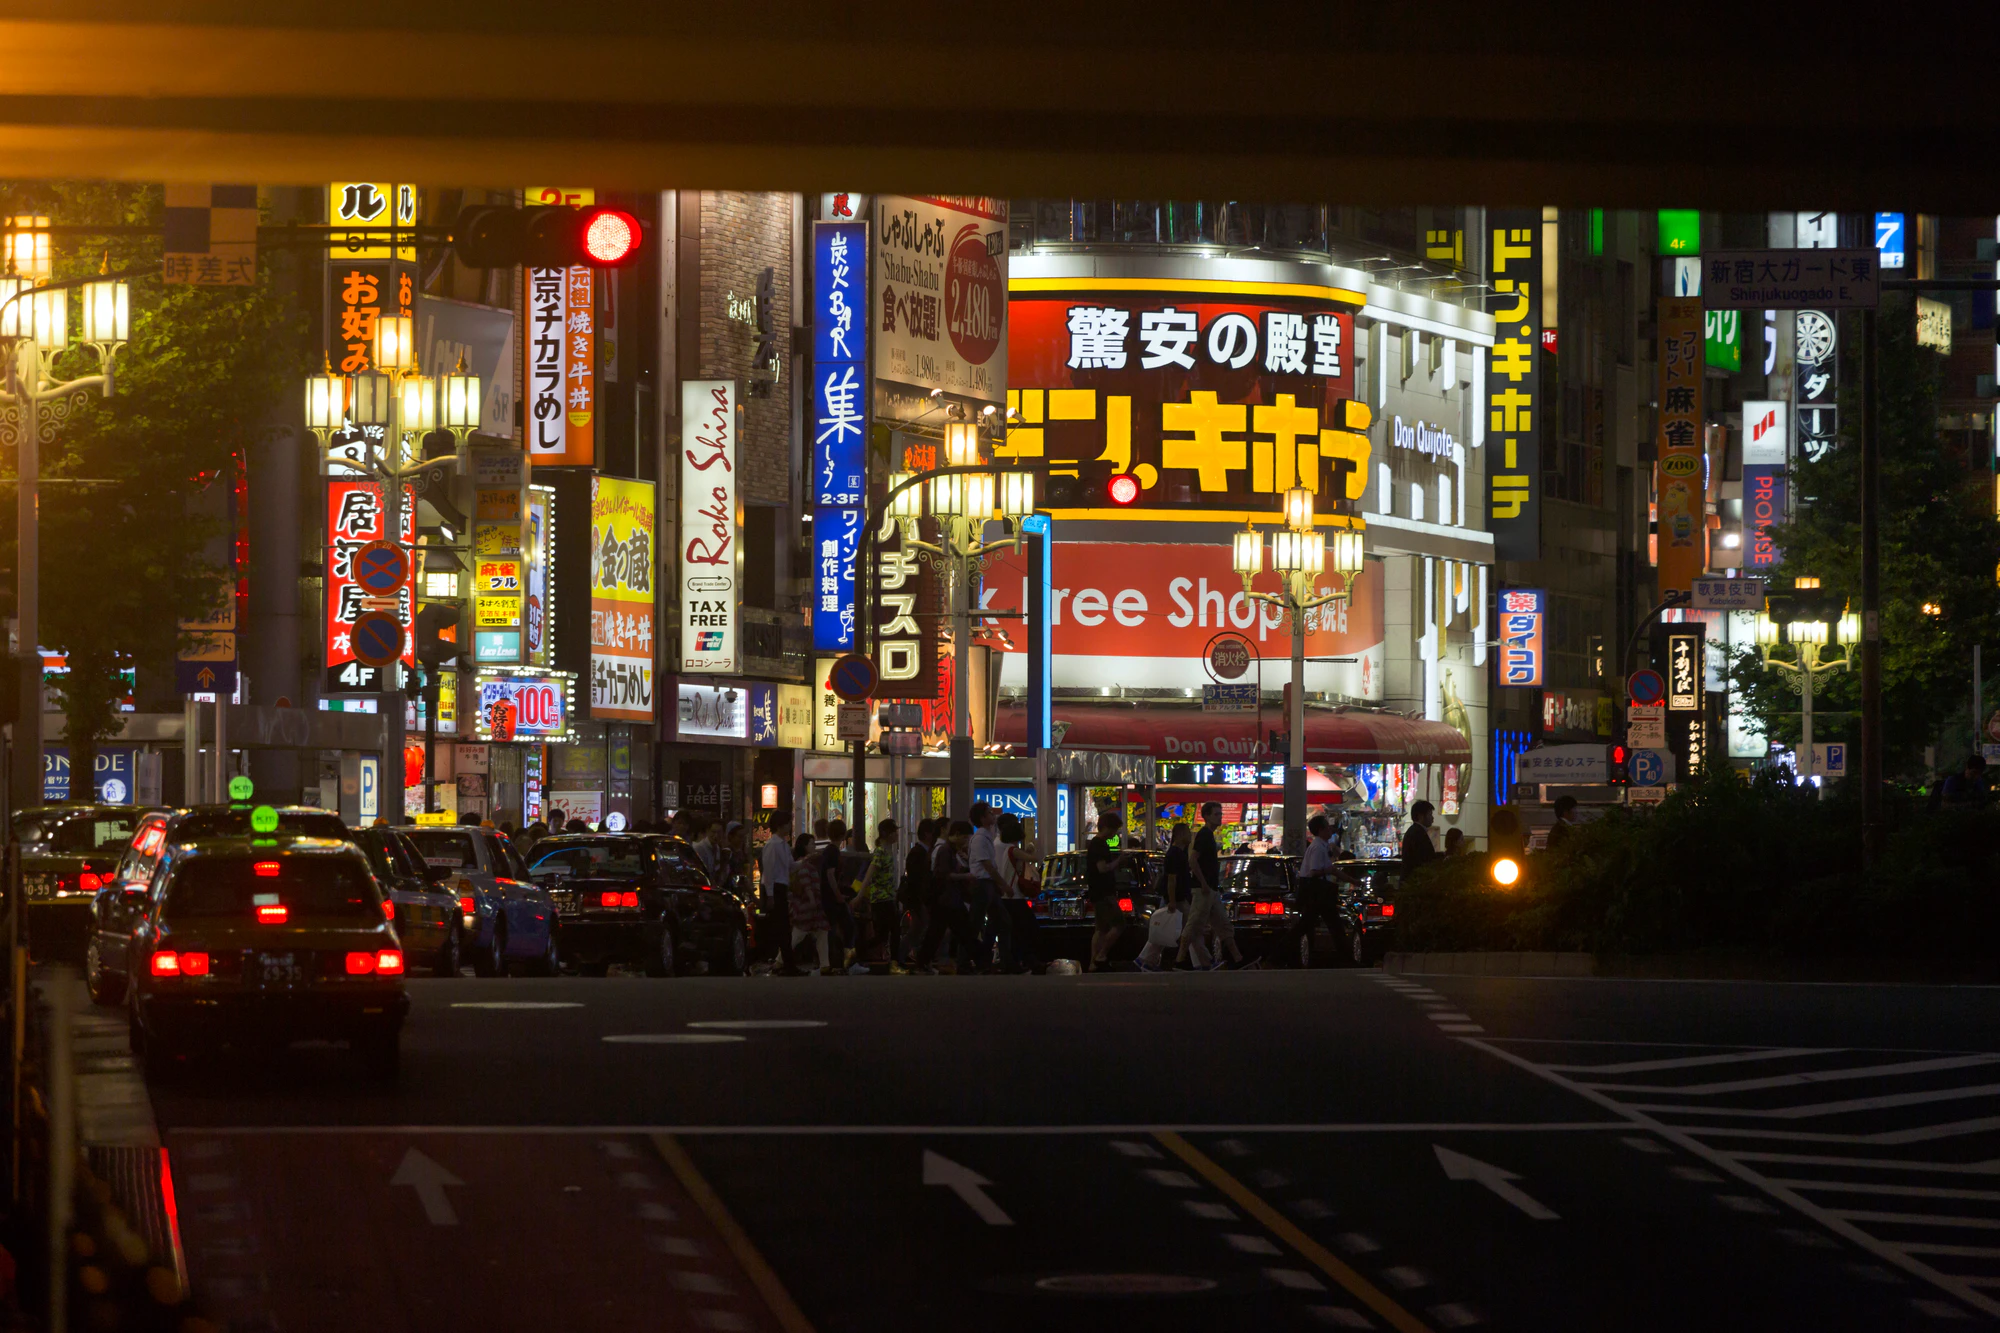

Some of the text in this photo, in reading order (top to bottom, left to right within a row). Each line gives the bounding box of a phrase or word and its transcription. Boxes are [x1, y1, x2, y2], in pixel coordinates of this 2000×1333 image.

[881, 204, 945, 259] しゃぶしゃぶ
[1670, 238, 1686, 249] 4F
[165, 256, 253, 283] 時差式
[1711, 257, 1872, 284] 新宿大ガード東
[951, 278, 990, 343] 2,480
[1730, 286, 1834, 303] Shinjukuogado
[1067, 306, 1341, 377] 驚安の殿堂
[1683, 331, 1696, 376] フリー
[568, 310, 593, 411] 焼き牛丼
[1665, 338, 1680, 381] セット
[816, 366, 864, 444] 集
[1664, 387, 1696, 447] 麻雀
[1803, 373, 1830, 463] ダーツ
[1394, 415, 1453, 459] Don Quijote
[1663, 460, 1696, 471] ZOO
[1755, 476, 1773, 564] PROMISE
[842, 510, 858, 582] ワインと
[480, 562, 515, 577] 麻雀
[490, 577, 518, 588] ブル
[821, 540, 839, 613] 創作料理
[689, 601, 727, 613] TAX
[1507, 591, 1537, 612] 薬
[1698, 583, 1757, 596] 歌舞伎町
[605, 609, 652, 652] 焼き牛丼
[690, 615, 727, 626] FREE
[685, 658, 731, 668] ロコシーラ
[1214, 651, 1247, 667] 消火栓
[1507, 614, 1538, 685] ダイコク
[1674, 640, 1693, 694] 十割そば
[339, 663, 375, 686] 4F
[597, 659, 652, 706] チカラめし
[514, 687, 555, 726] 100
[824, 693, 836, 746] 養老乃
[1543, 697, 1555, 726] 4F
[1165, 736, 1207, 753] Don
[1831, 747, 1841, 761] P
[363, 765, 374, 809] P
[1636, 758, 1657, 781] P 40
[686, 784, 717, 795] TAX
[686, 795, 718, 805] FREE
[1058, 794, 1066, 829] P
